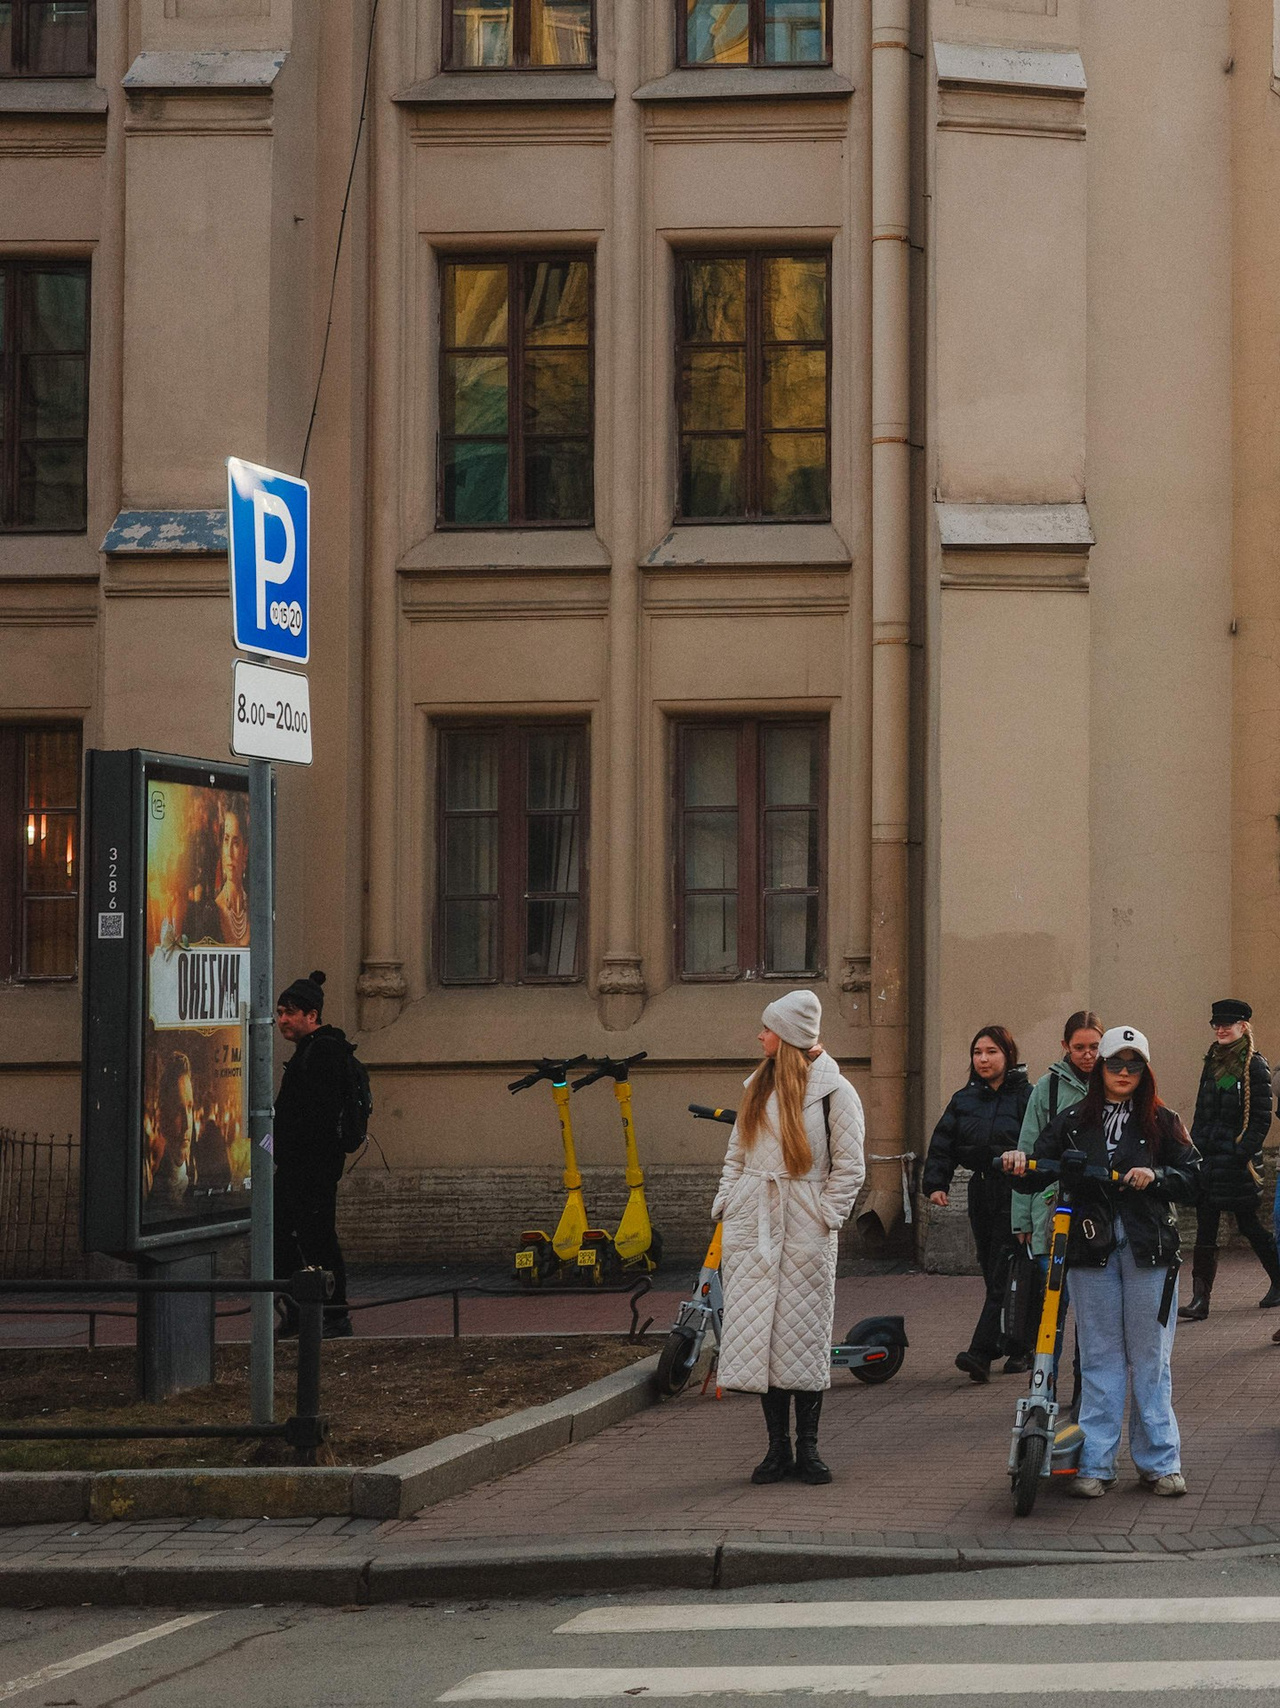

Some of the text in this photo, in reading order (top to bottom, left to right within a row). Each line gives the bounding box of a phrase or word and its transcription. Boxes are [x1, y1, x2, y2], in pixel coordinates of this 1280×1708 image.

[254, 488, 296, 631] P
[237, 692, 308, 734] 8.00-20.00
[108, 847, 118, 910] 3286
[178, 952, 241, 1020] ОНЕГИН
[1123, 1030, 1134, 1041] C
